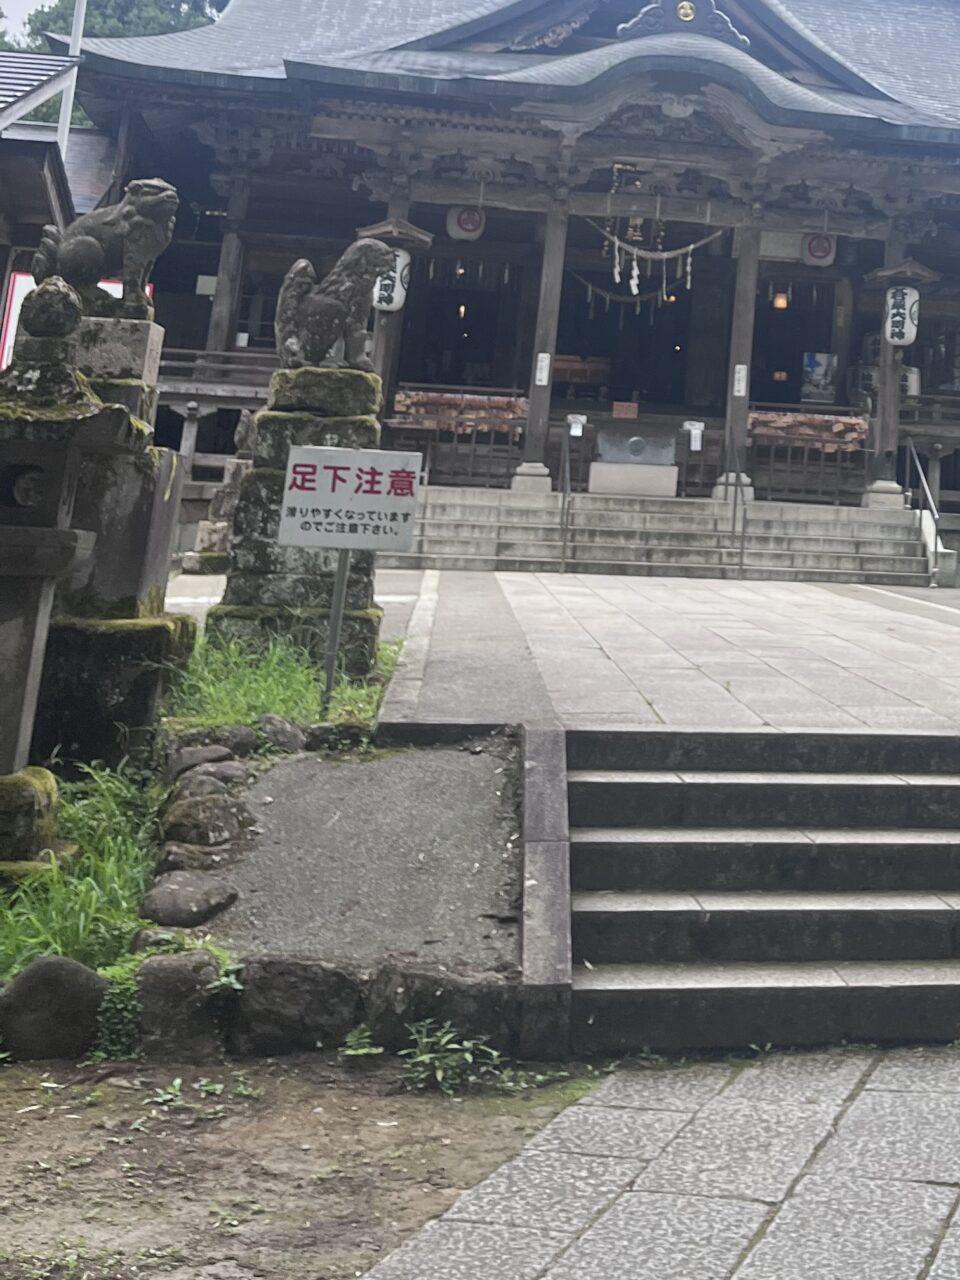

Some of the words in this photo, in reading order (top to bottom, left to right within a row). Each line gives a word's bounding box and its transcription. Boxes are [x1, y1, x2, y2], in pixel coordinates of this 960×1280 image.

[288, 463, 416, 497] 足下注意
[286, 506, 411, 523] 滑りやすくなっています
[300, 521, 398, 536] のでご注意下さい。
